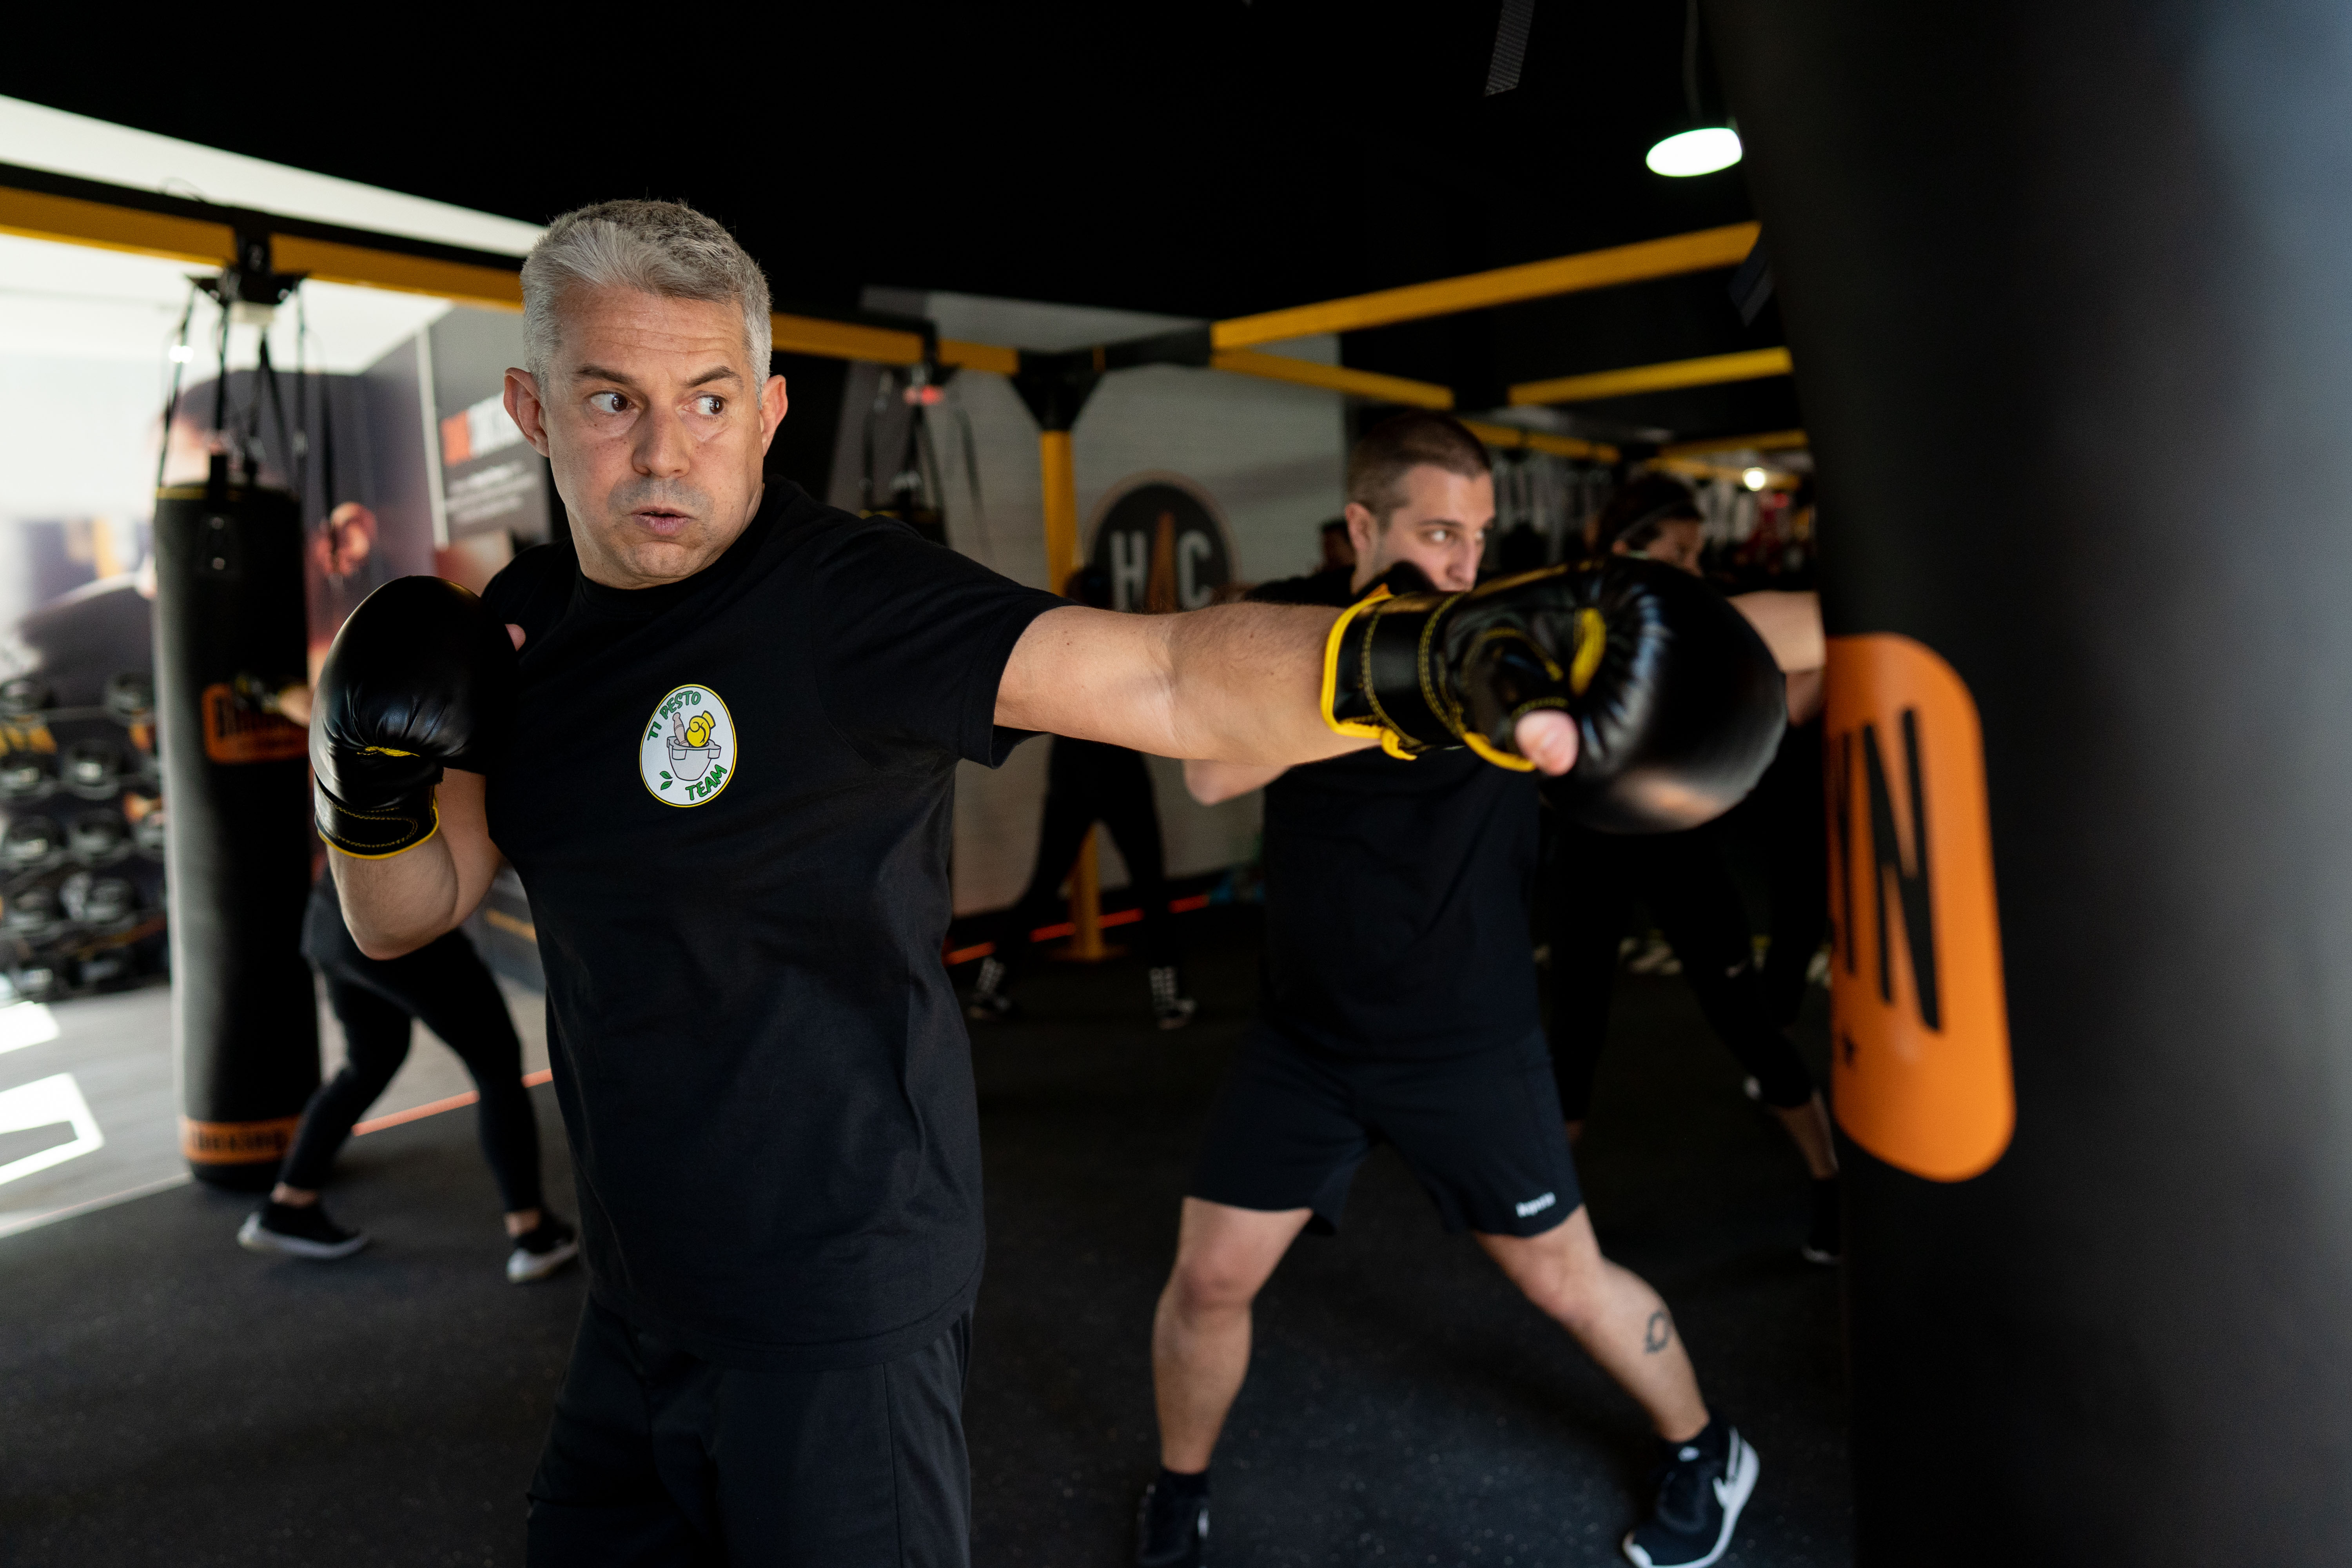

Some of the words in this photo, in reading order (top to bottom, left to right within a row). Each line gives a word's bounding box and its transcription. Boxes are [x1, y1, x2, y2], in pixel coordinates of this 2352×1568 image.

[647, 721, 662, 740] TI
[660, 691, 701, 719] PESTO
[685, 764, 727, 800] TEAM
